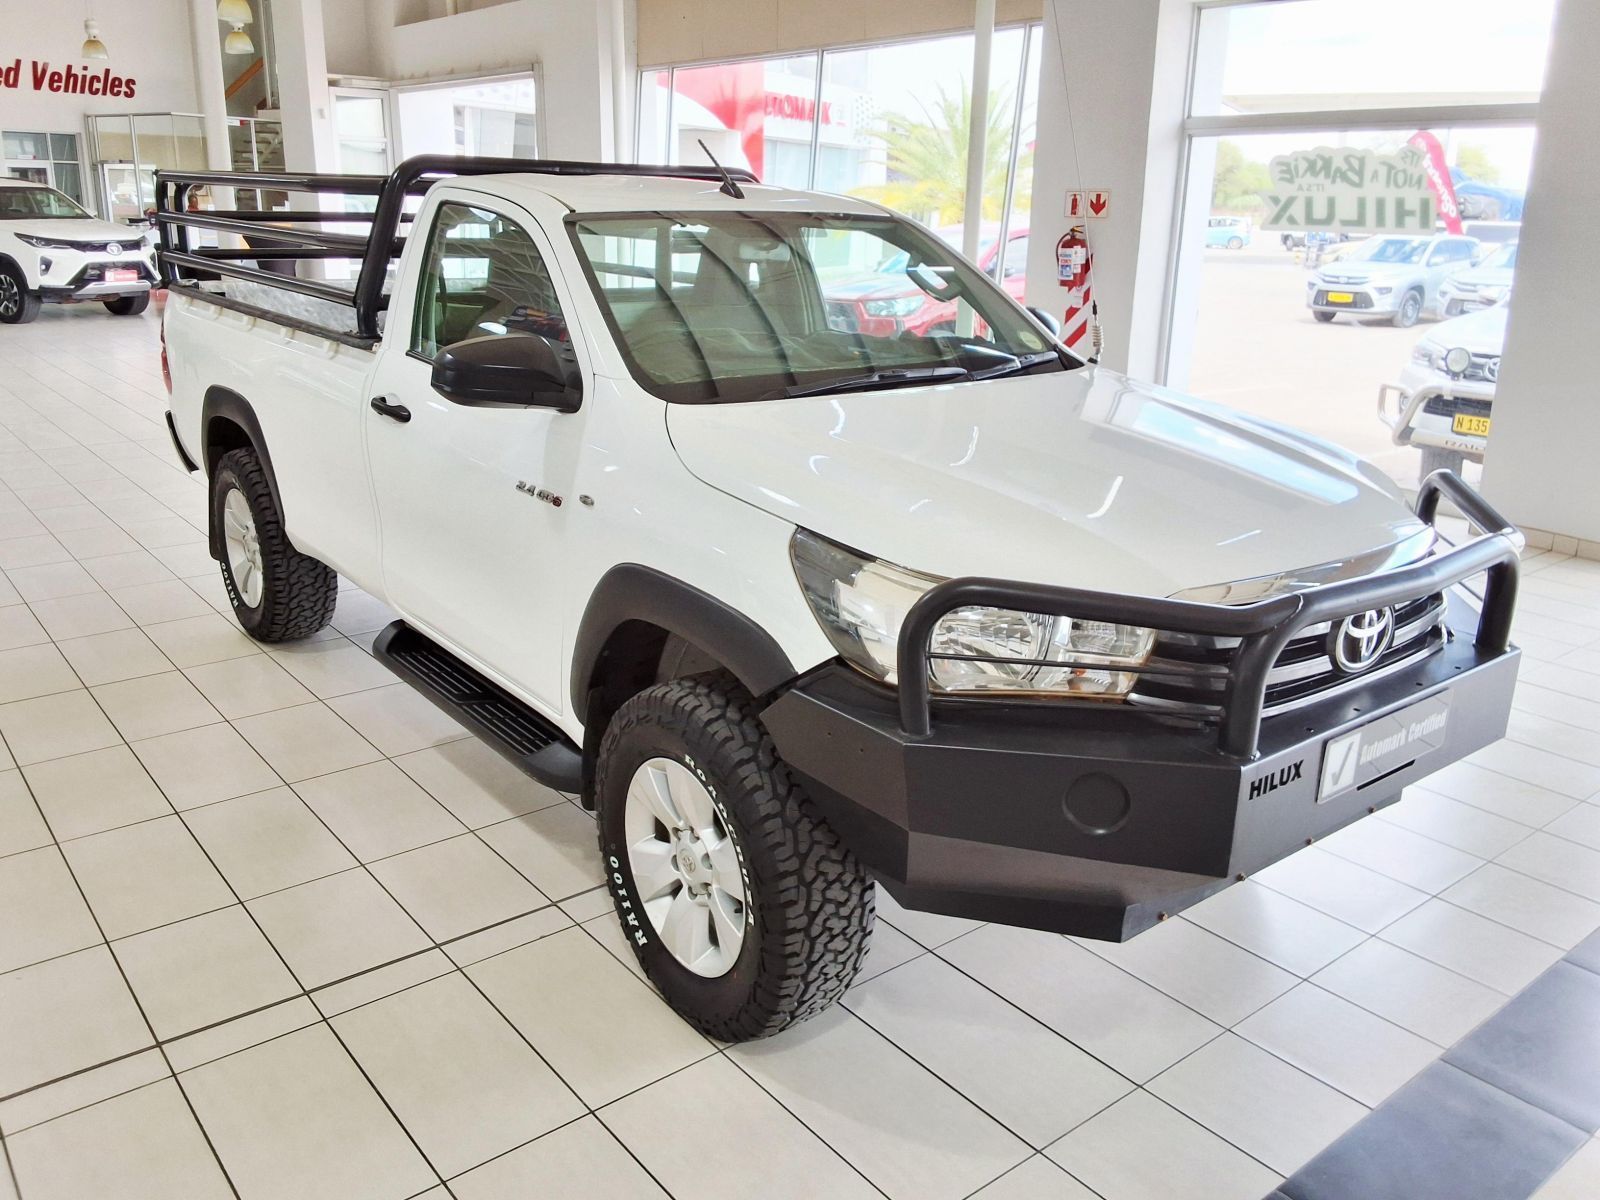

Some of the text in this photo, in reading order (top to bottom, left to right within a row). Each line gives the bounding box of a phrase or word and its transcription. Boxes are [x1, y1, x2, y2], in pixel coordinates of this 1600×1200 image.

[31, 60, 137, 99] Vehicles
[1359, 708, 1449, 766] Automark Certified
[1249, 759, 1305, 801] HILUX
